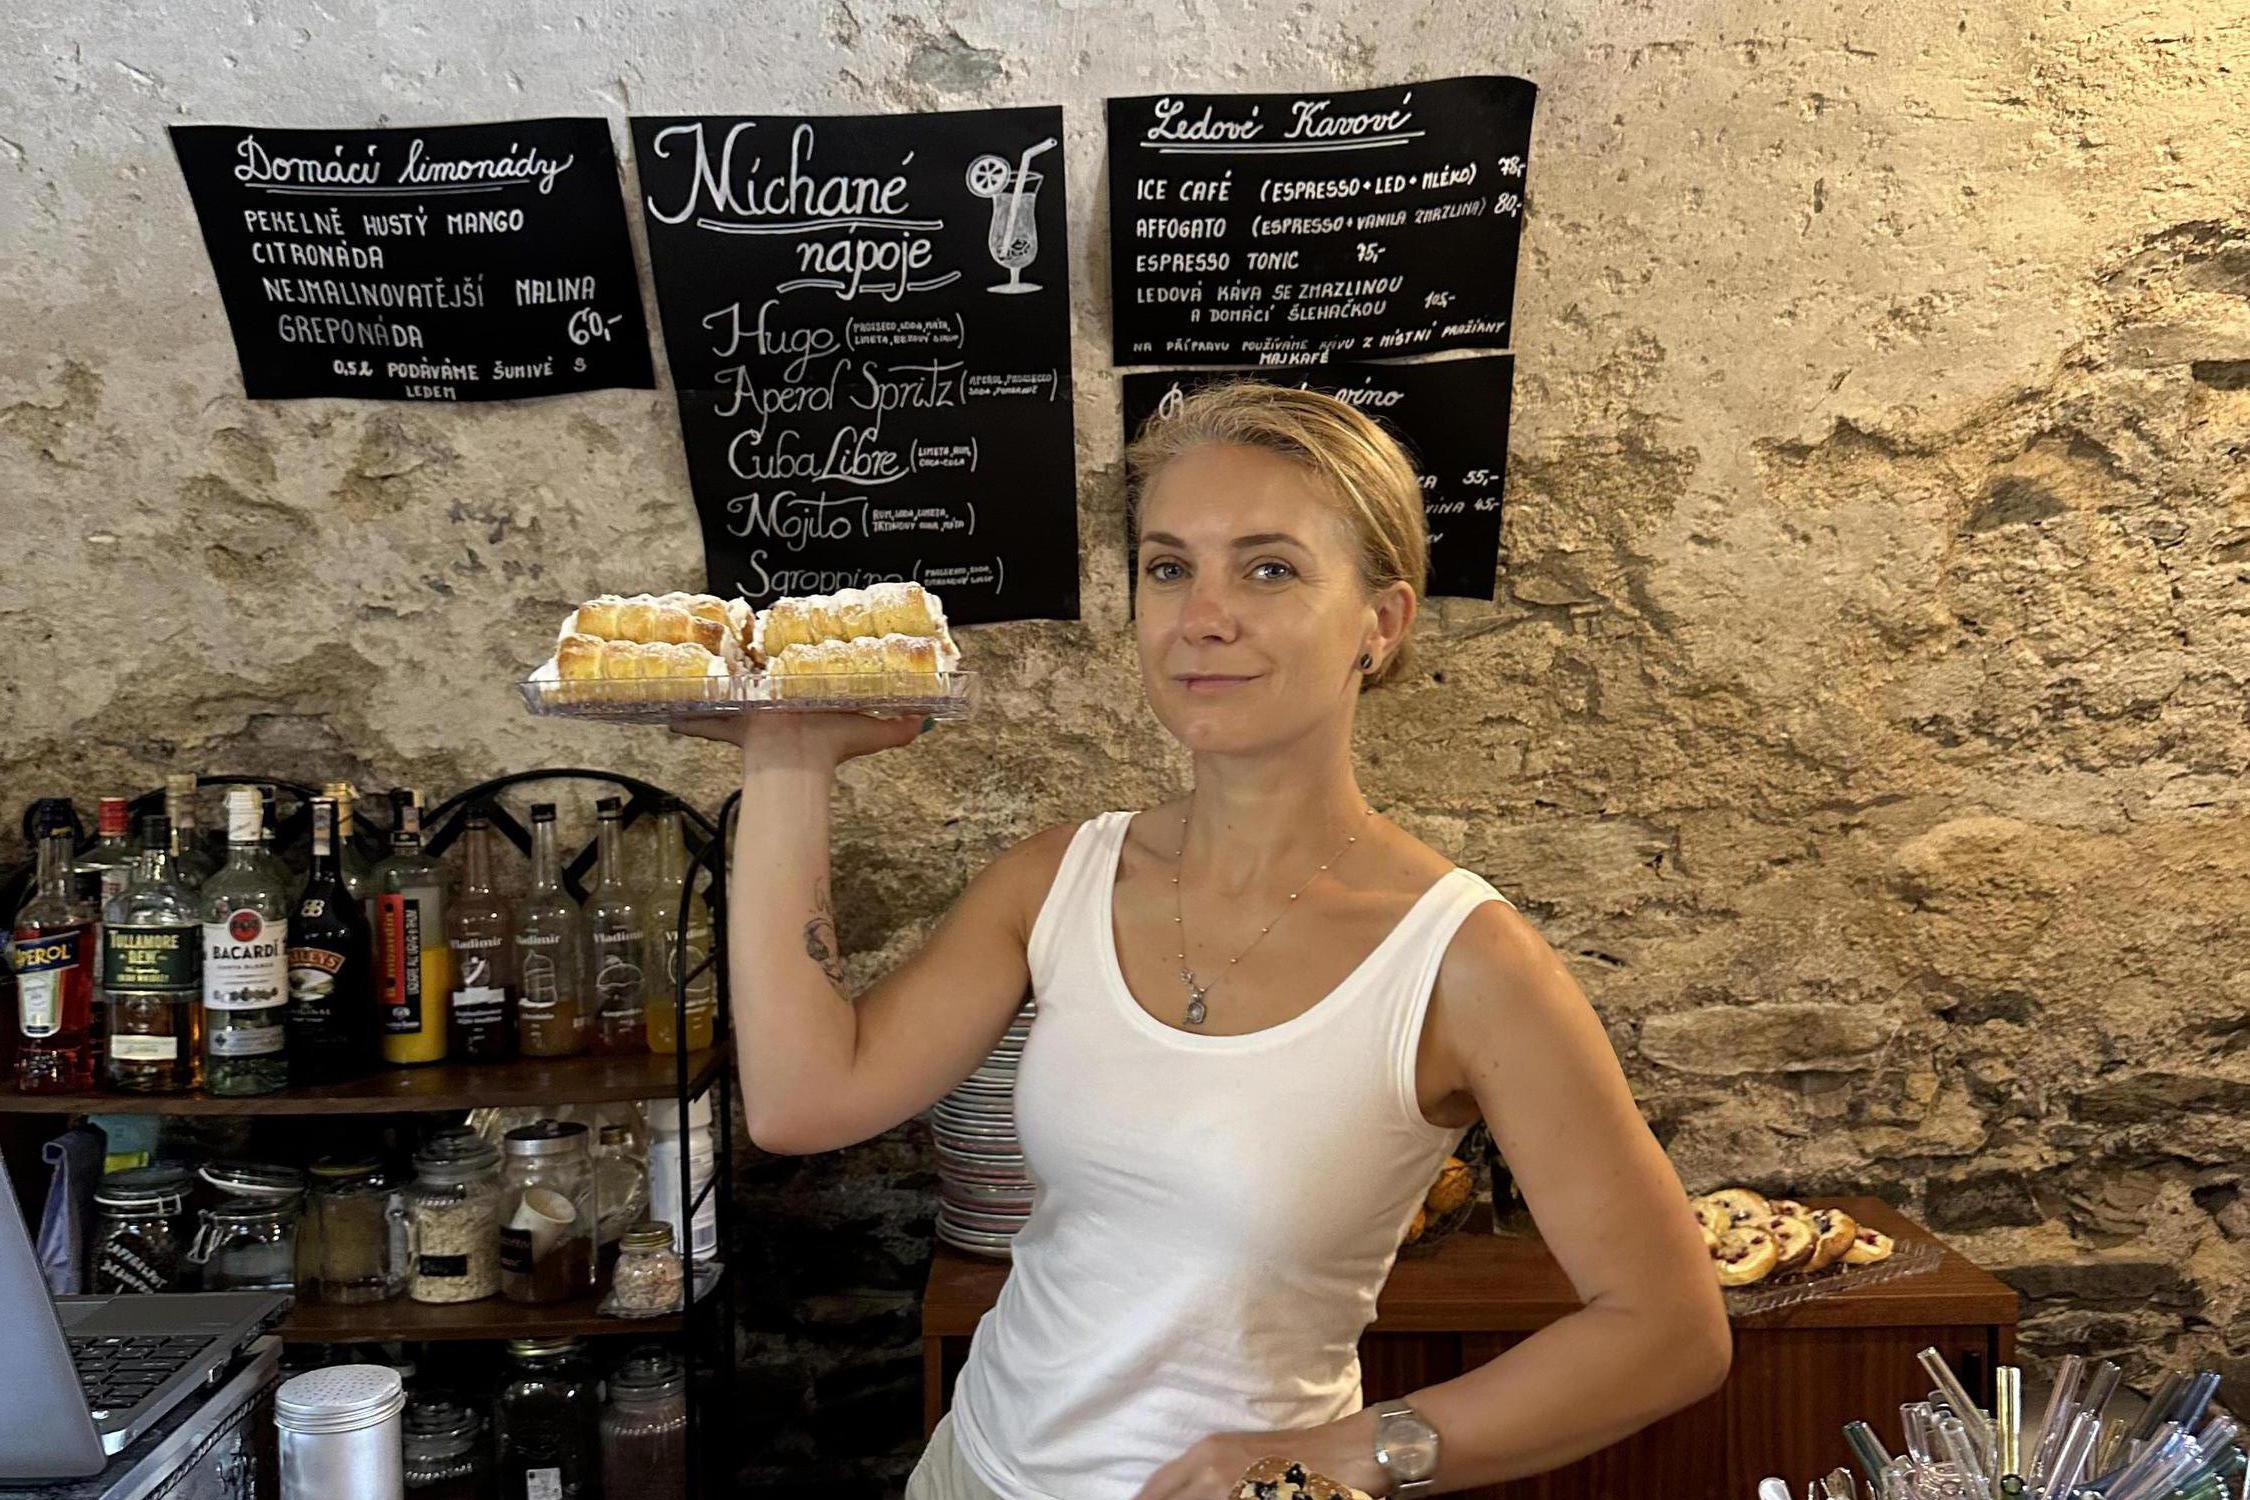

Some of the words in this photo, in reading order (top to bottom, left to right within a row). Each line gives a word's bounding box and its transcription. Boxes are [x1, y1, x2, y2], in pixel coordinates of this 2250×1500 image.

[1147, 98, 1264, 140] Ledové
[234, 135, 381, 184] Domácí
[399, 139, 573, 193] limonády
[1137, 179, 1166, 200] ICE
[1180, 170, 1231, 202] CAFÉ
[1376, 177, 1403, 195] LED
[244, 207, 345, 235] PEKELNĚ
[364, 206, 428, 236] HUSTÝ
[448, 210, 523, 234] MANGO
[1137, 218, 1227, 238] AFFOGATO
[1357, 211, 1407, 232] VANILA
[253, 241, 384, 269] CITRONÁDA
[1137, 254, 1230, 272] ESPRESSO
[1247, 251, 1299, 271] TONIC
[263, 275, 484, 307] NEJMALINOVATĚJŠÍ
[517, 276, 596, 305] MALINA
[1137, 280, 1202, 304] LEDOVÁ
[1218, 278, 1261, 301] KÁVA
[1273, 285, 1291, 300] SE
[1298, 276, 1403, 300] ZMRZLINOU
[1191, 309, 1200, 323] A
[1210, 304, 1276, 323] DOMÁCÍ
[1288, 300, 1386, 322] ŠLEHAČKOU
[279, 314, 423, 348] GREPONÁDA
[703, 299, 840, 383] Hugo
[1133, 342, 1152, 352] NA
[1363, 337, 1371, 349] Z
[388, 356, 479, 381] PODÁVÁME
[493, 355, 553, 380] ŠUMIVÉ
[406, 386, 455, 401] LEDEM
[714, 357, 851, 435] Aperol
[849, 357, 965, 440] Spritz
[727, 430, 823, 479] Cuba
[811, 426, 908, 485] Libre
[727, 490, 868, 552] Mojito
[109, 930, 179, 949] TULLAMORE
[288, 950, 340, 967] AILEYS
